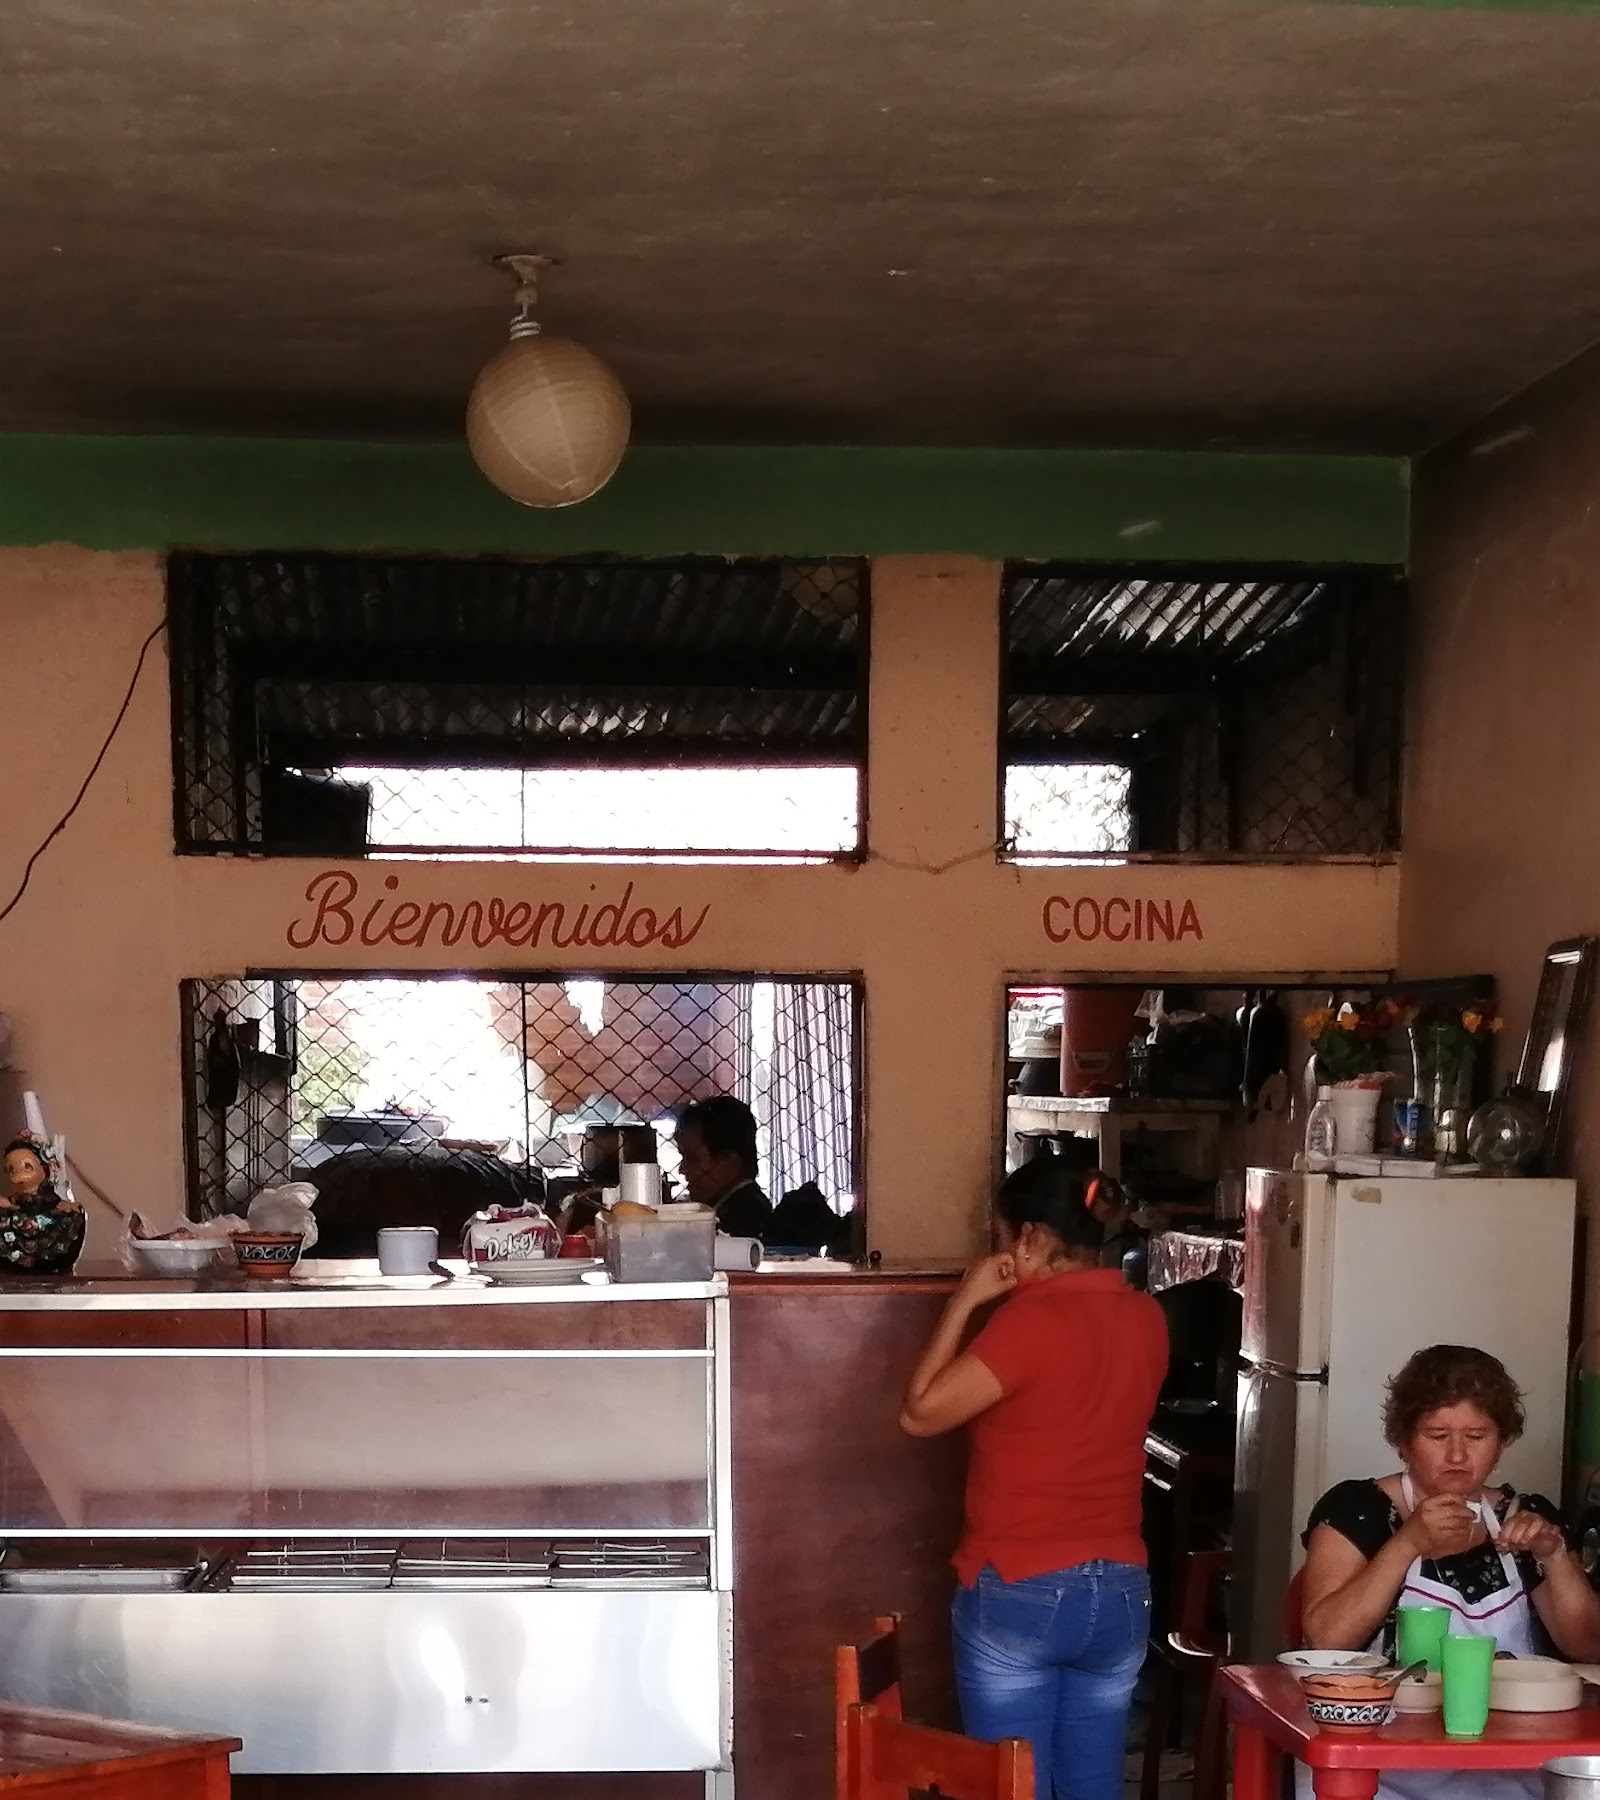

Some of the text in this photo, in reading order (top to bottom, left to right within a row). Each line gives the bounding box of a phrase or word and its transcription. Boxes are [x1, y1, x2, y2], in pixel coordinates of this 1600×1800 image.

[287, 870, 711, 949] Bienvenidos
[1043, 896, 1203, 943] COCINA
[486, 1230, 538, 1261] Delsey
